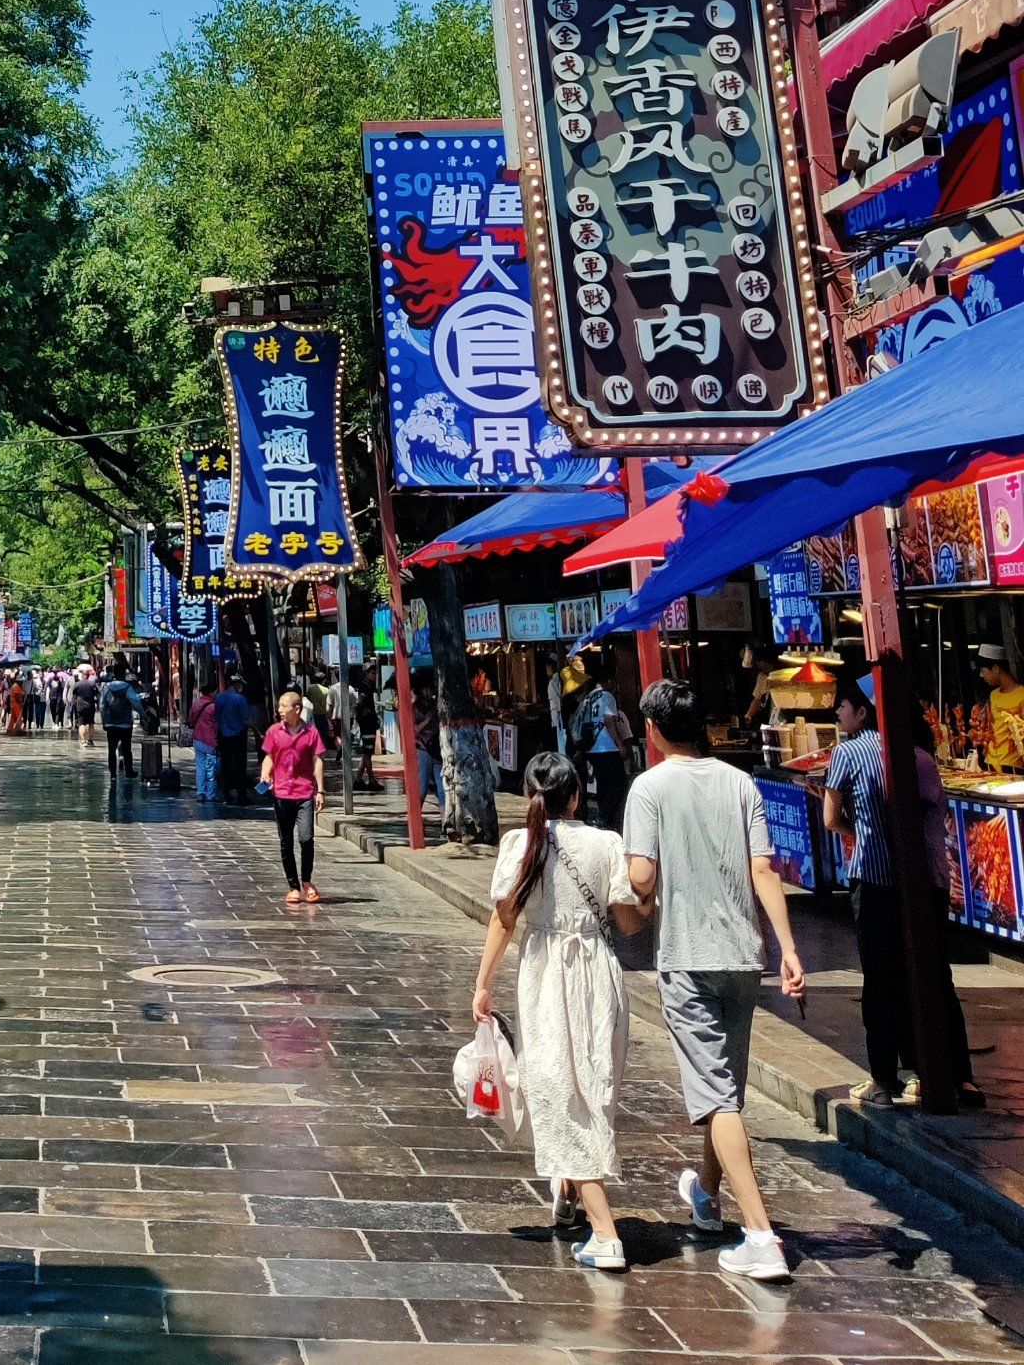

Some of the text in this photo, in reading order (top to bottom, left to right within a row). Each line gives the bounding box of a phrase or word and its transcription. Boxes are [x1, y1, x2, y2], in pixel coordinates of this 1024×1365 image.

[710, 5, 747, 133] 西特產
[431, 184, 524, 226] 鱿鱼
[254, 336, 319, 364] 特色
[610, 379, 764, 402] 代办快递
[244, 531, 344, 556] 老字号
